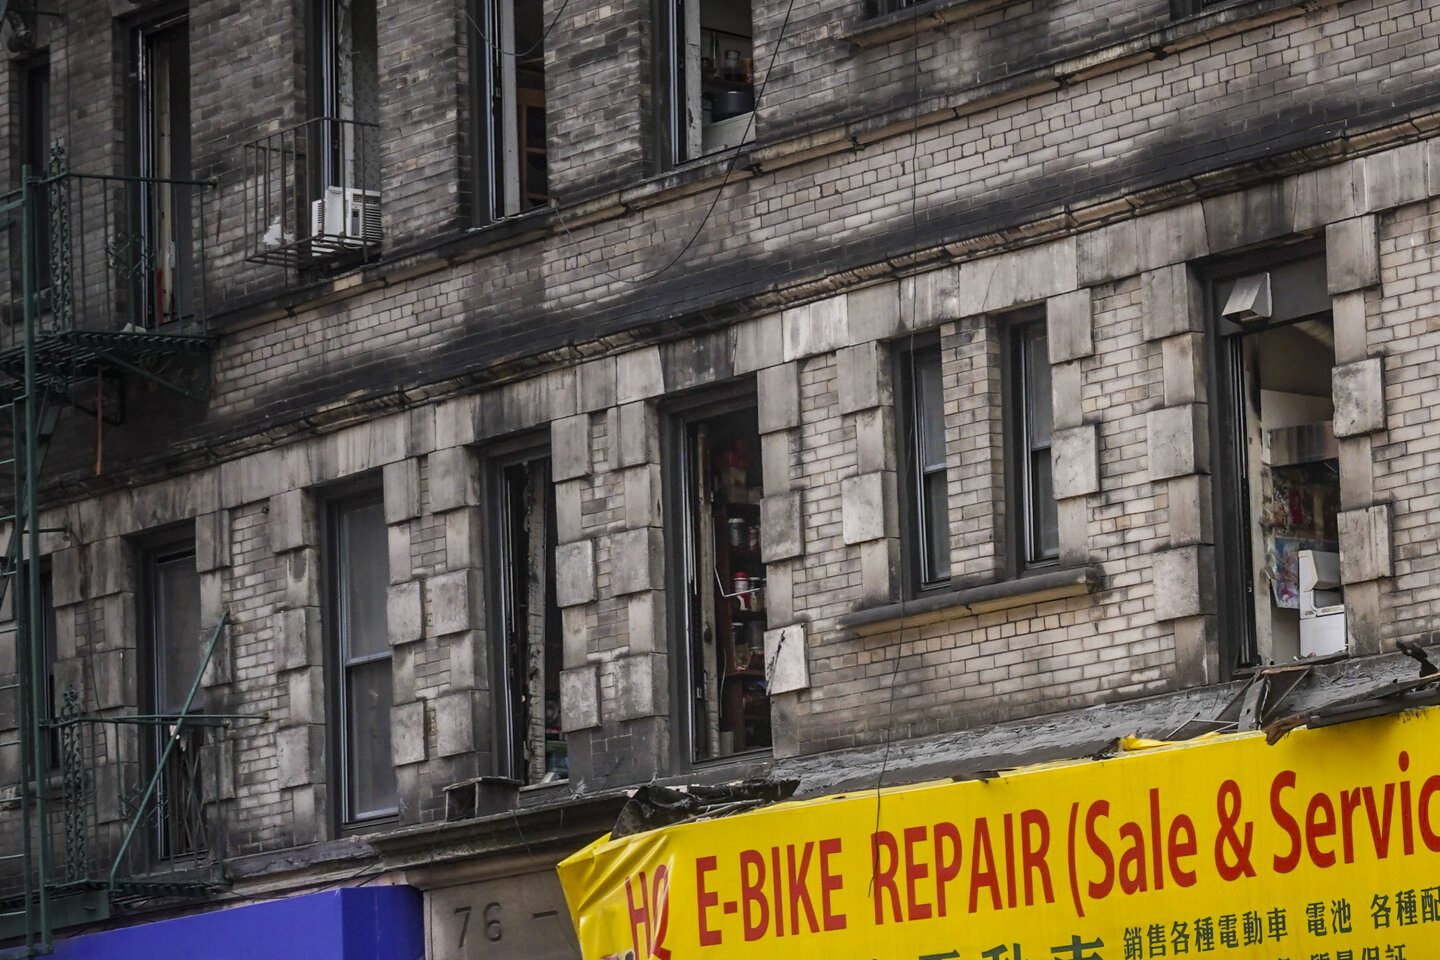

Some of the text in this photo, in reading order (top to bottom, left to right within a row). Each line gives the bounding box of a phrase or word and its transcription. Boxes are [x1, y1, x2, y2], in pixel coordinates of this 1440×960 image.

[696, 839, 847, 947] E-BIKE
[871, 810, 1055, 925] REPAIR
[1068, 788, 1198, 917] (Sale
[1215, 780, 1257, 882] &
[454, 901, 502, 950] 76
[1305, 898, 1353, 938] 電池
